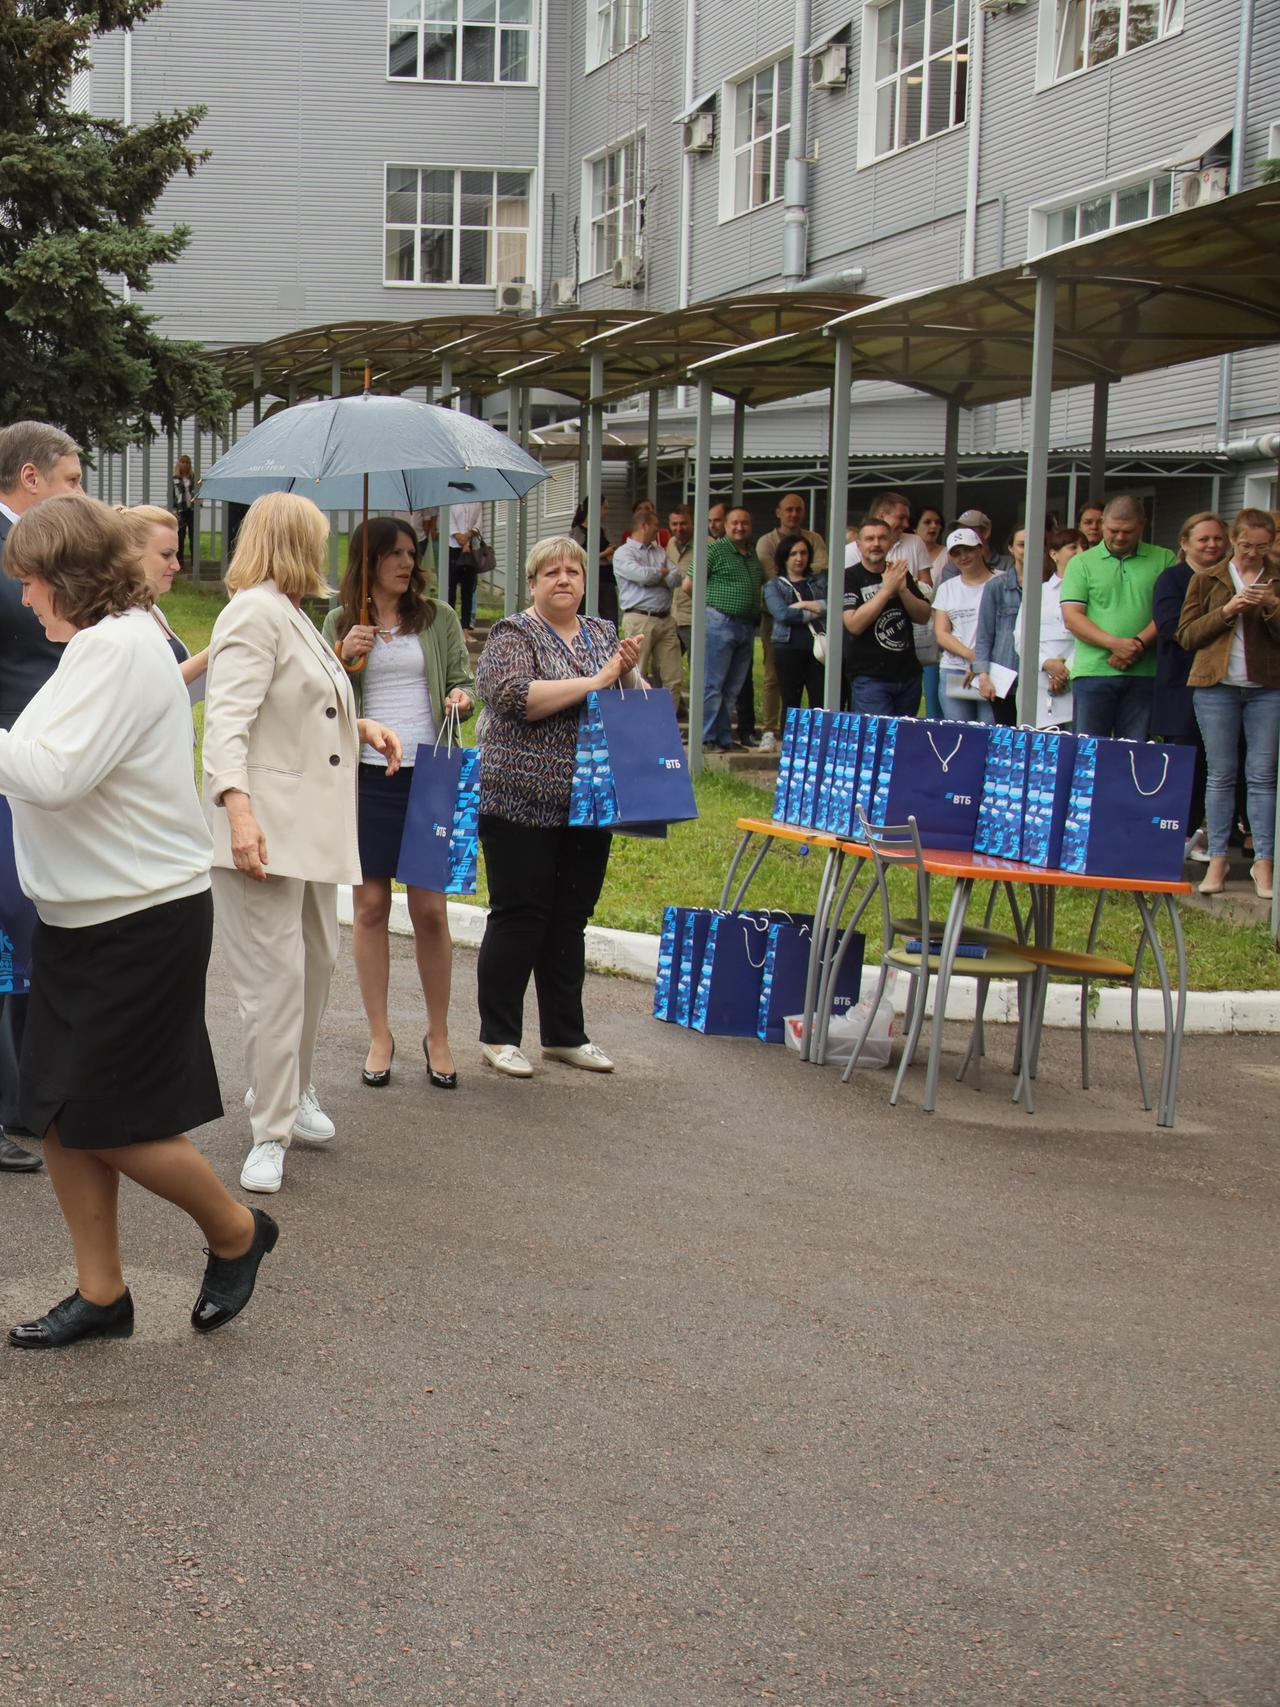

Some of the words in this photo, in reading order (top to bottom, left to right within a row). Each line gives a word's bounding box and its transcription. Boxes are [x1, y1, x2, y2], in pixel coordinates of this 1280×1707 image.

[666, 758, 680, 768] ВТБ
[953, 794, 971, 804] ВТБ
[1160, 820, 1179, 830] ВТБ
[436, 825, 447, 838] ВТБ
[834, 997, 851, 1006] ВТБ
